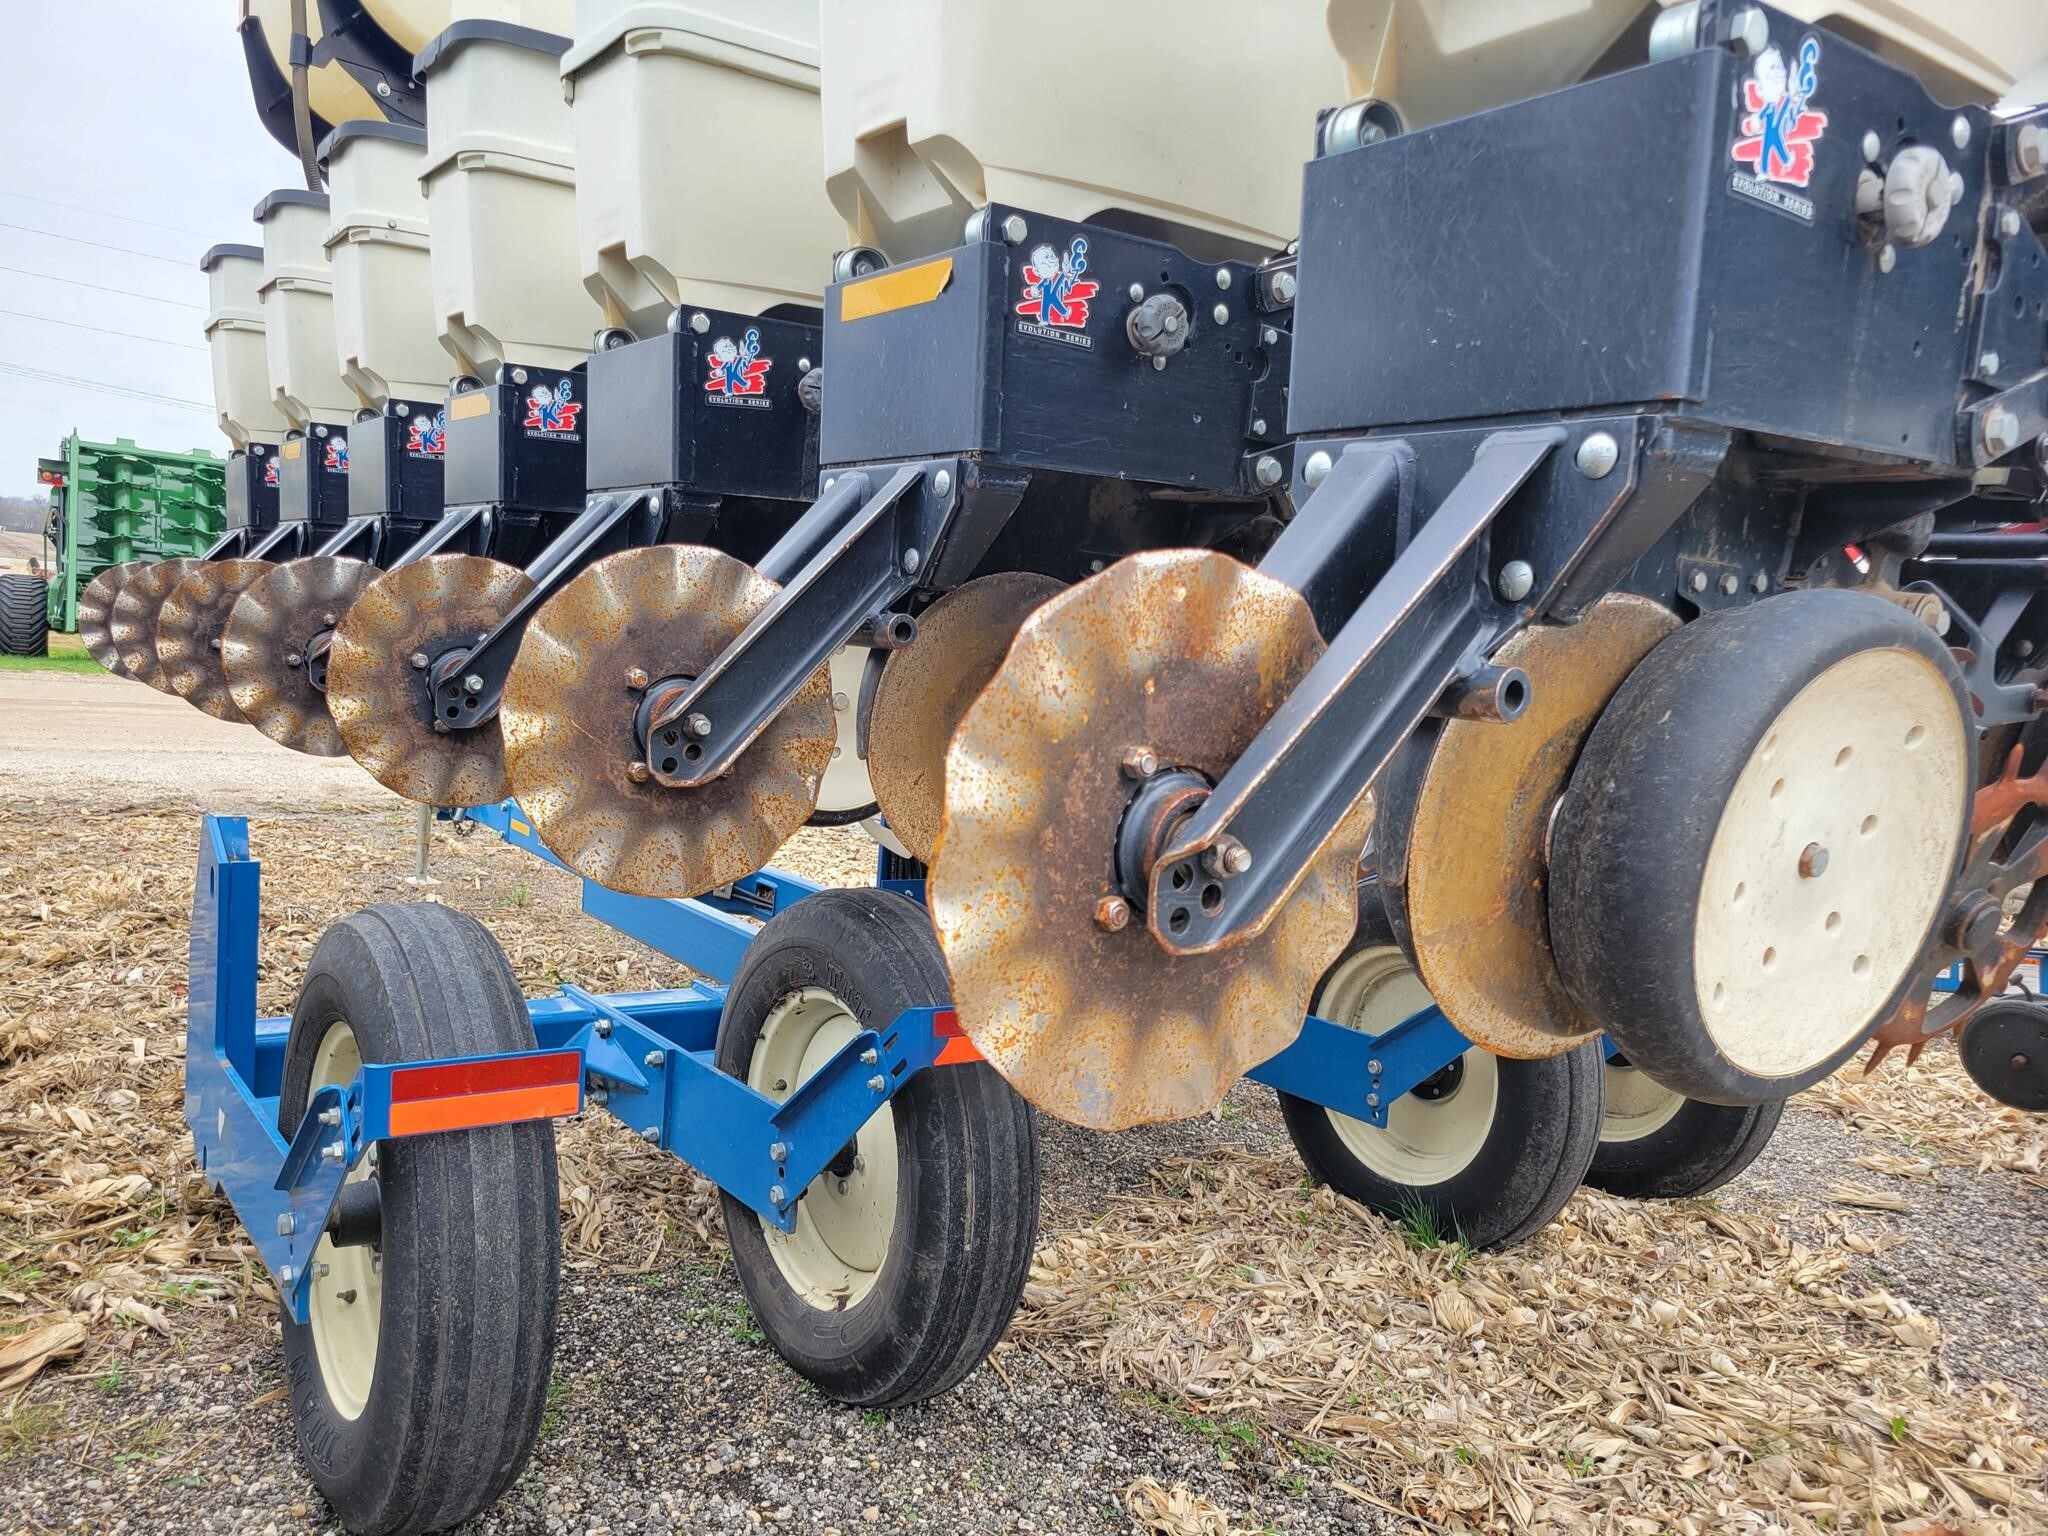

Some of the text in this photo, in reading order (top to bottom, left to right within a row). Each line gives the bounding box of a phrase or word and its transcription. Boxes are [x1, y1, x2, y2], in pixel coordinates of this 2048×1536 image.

[1732, 176, 1813, 217] EVOLUTION SERIES
[1018, 323, 1091, 345] EVOLUTION SERIES
[708, 396, 744, 405] EVOLUTION
